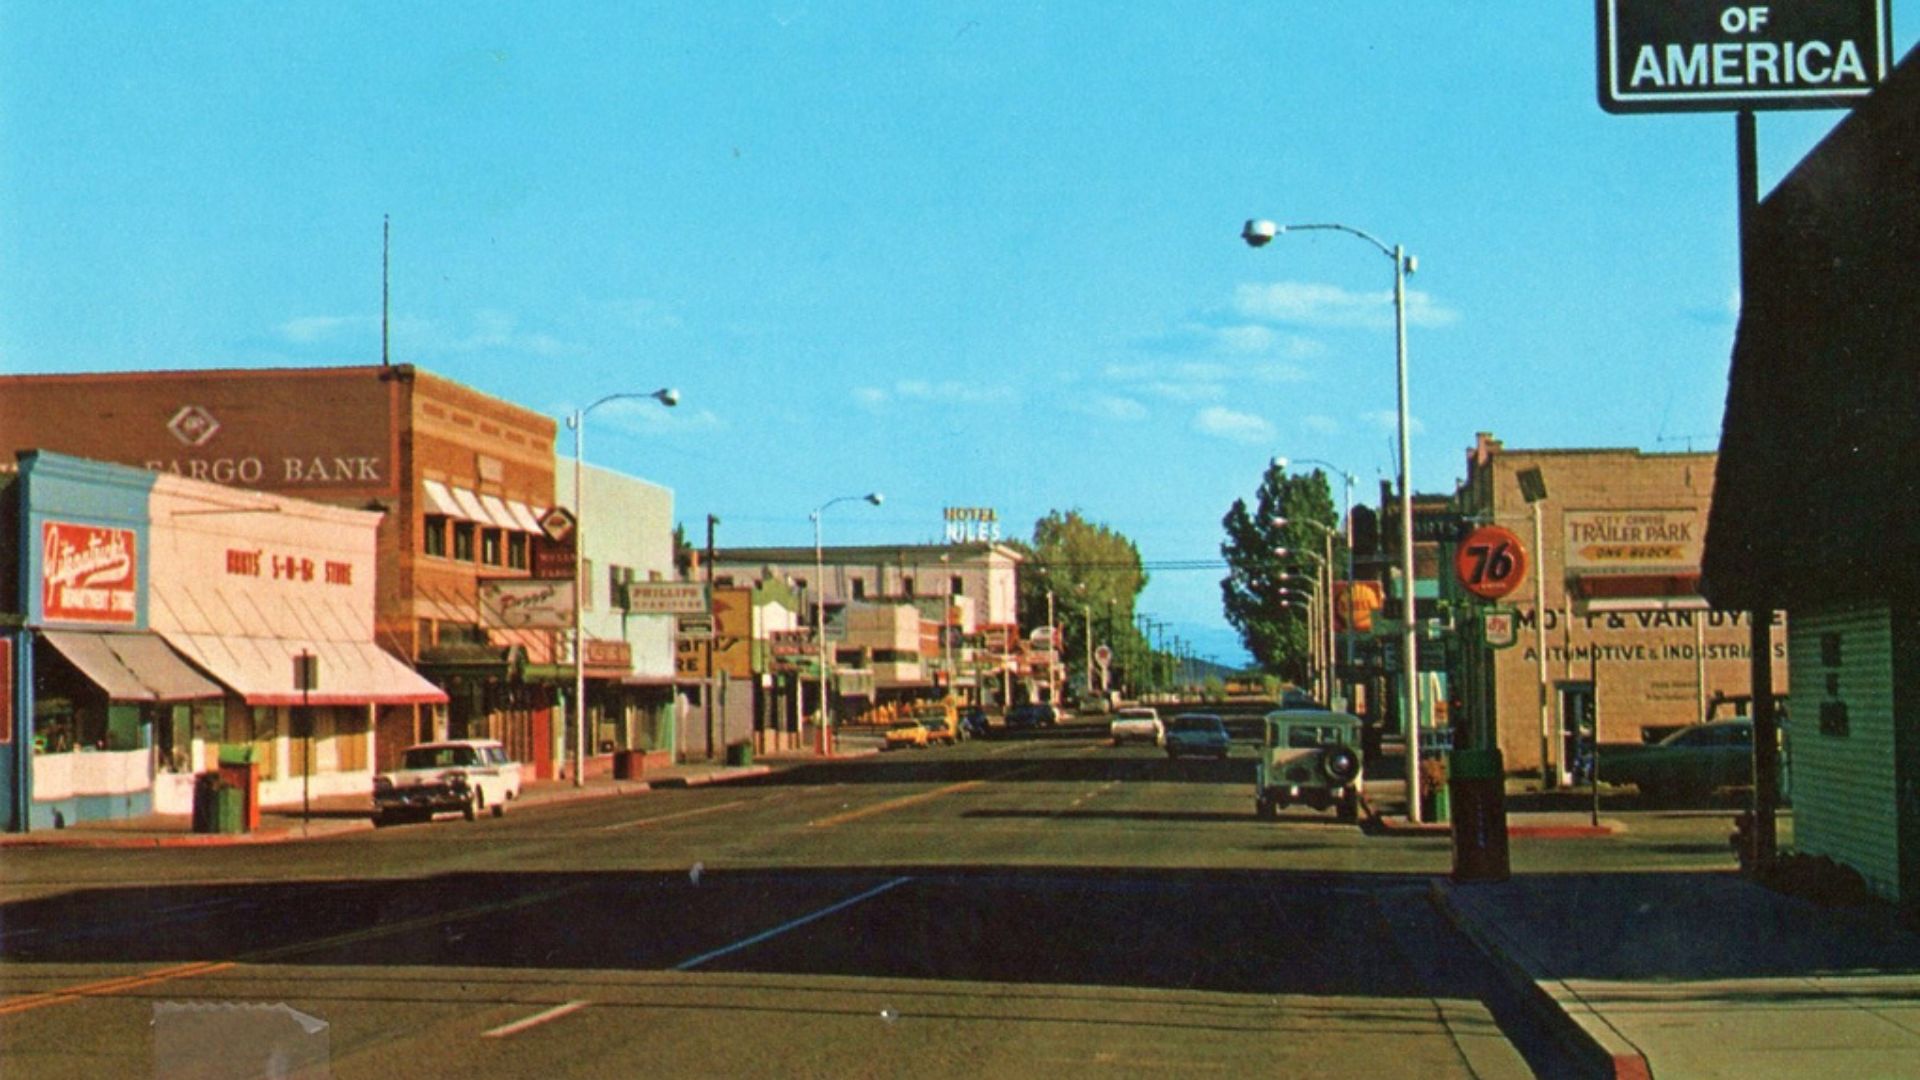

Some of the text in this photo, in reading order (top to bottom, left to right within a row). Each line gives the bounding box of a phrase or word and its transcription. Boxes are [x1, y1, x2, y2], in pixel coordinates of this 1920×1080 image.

[1720, 7, 1769, 33] OF
[1630, 40, 1868, 86] AMERICA
[283, 457, 381, 481] BANK
[1570, 520, 1692, 542] TRAILER PARK
[1467, 539, 1514, 584] 76
[633, 587, 698, 598] PHILLIPS
[1516, 608, 1783, 630] MOT & VAN DYE
[1663, 643, 1785, 660] INDSTRIS
